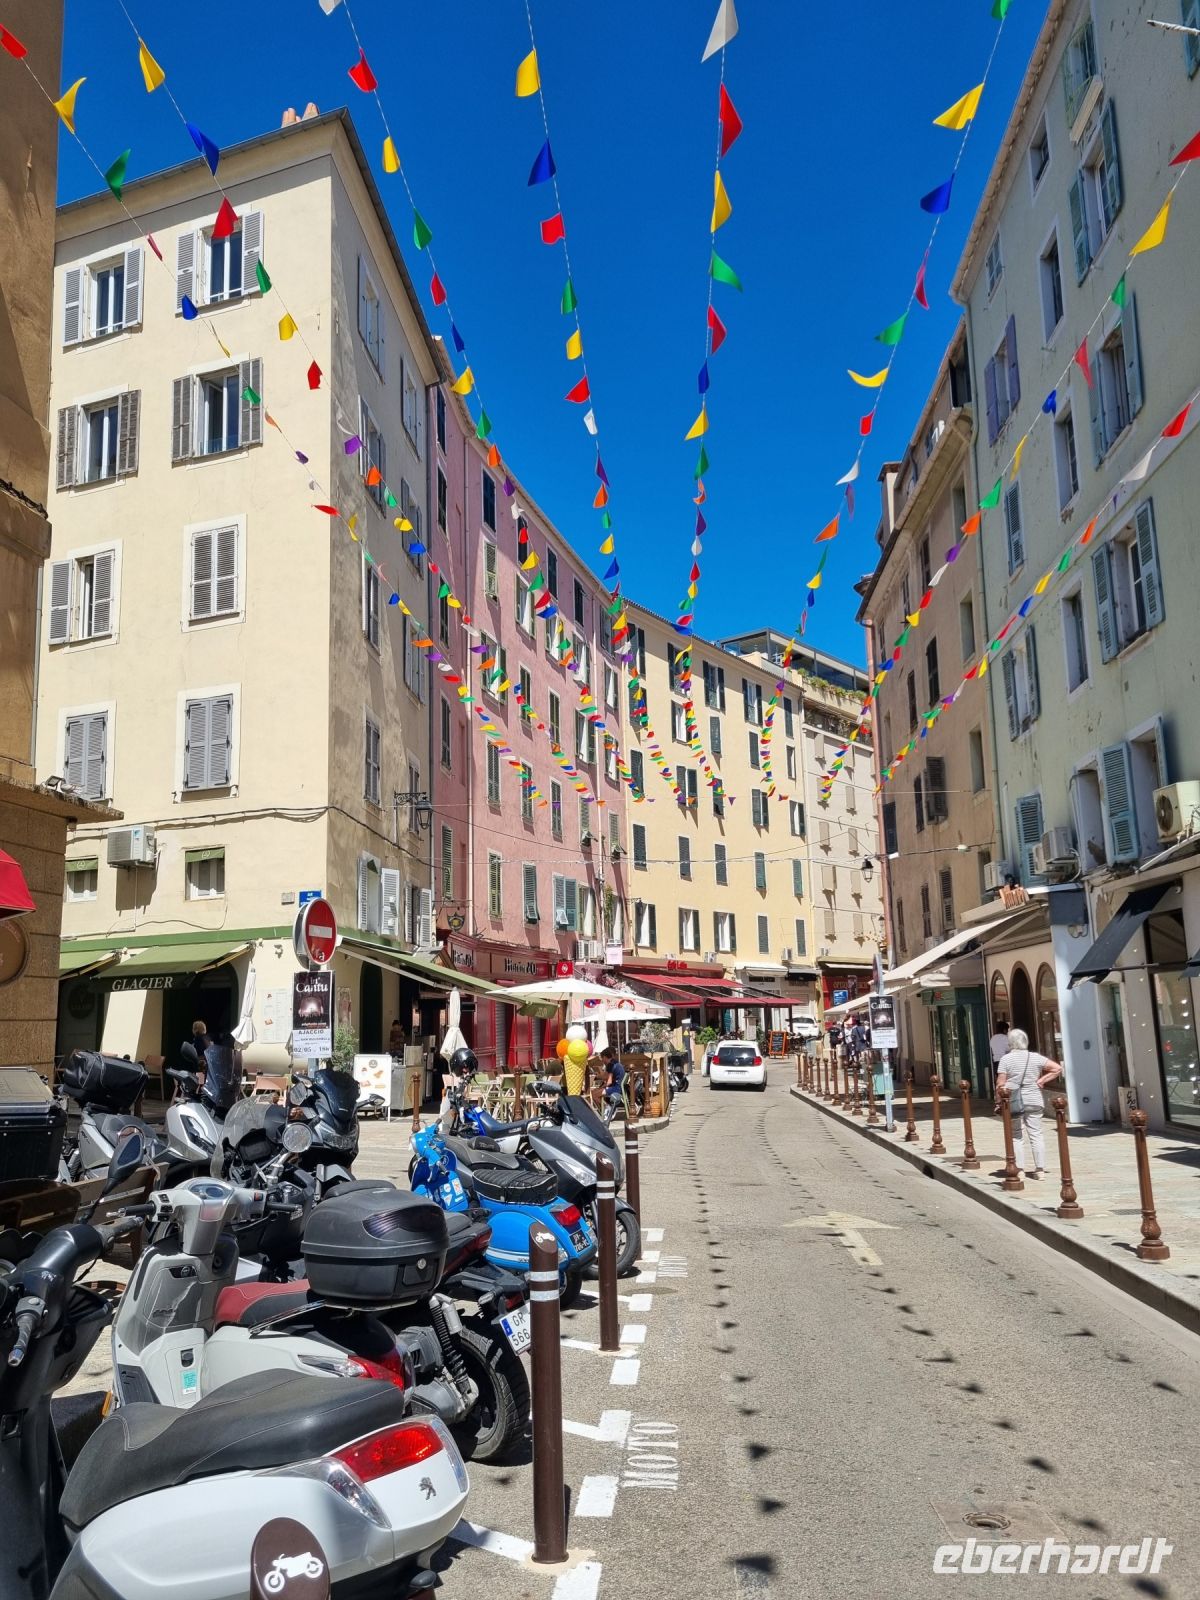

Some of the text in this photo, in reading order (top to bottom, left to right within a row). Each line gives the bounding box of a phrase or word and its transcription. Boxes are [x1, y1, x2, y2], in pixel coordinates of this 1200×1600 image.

[112, 976, 174, 991] GLACIER
[296, 982, 329, 993] Cantu
[511, 1328, 530, 1346] 566
[622, 1421, 679, 1491] MOTO
